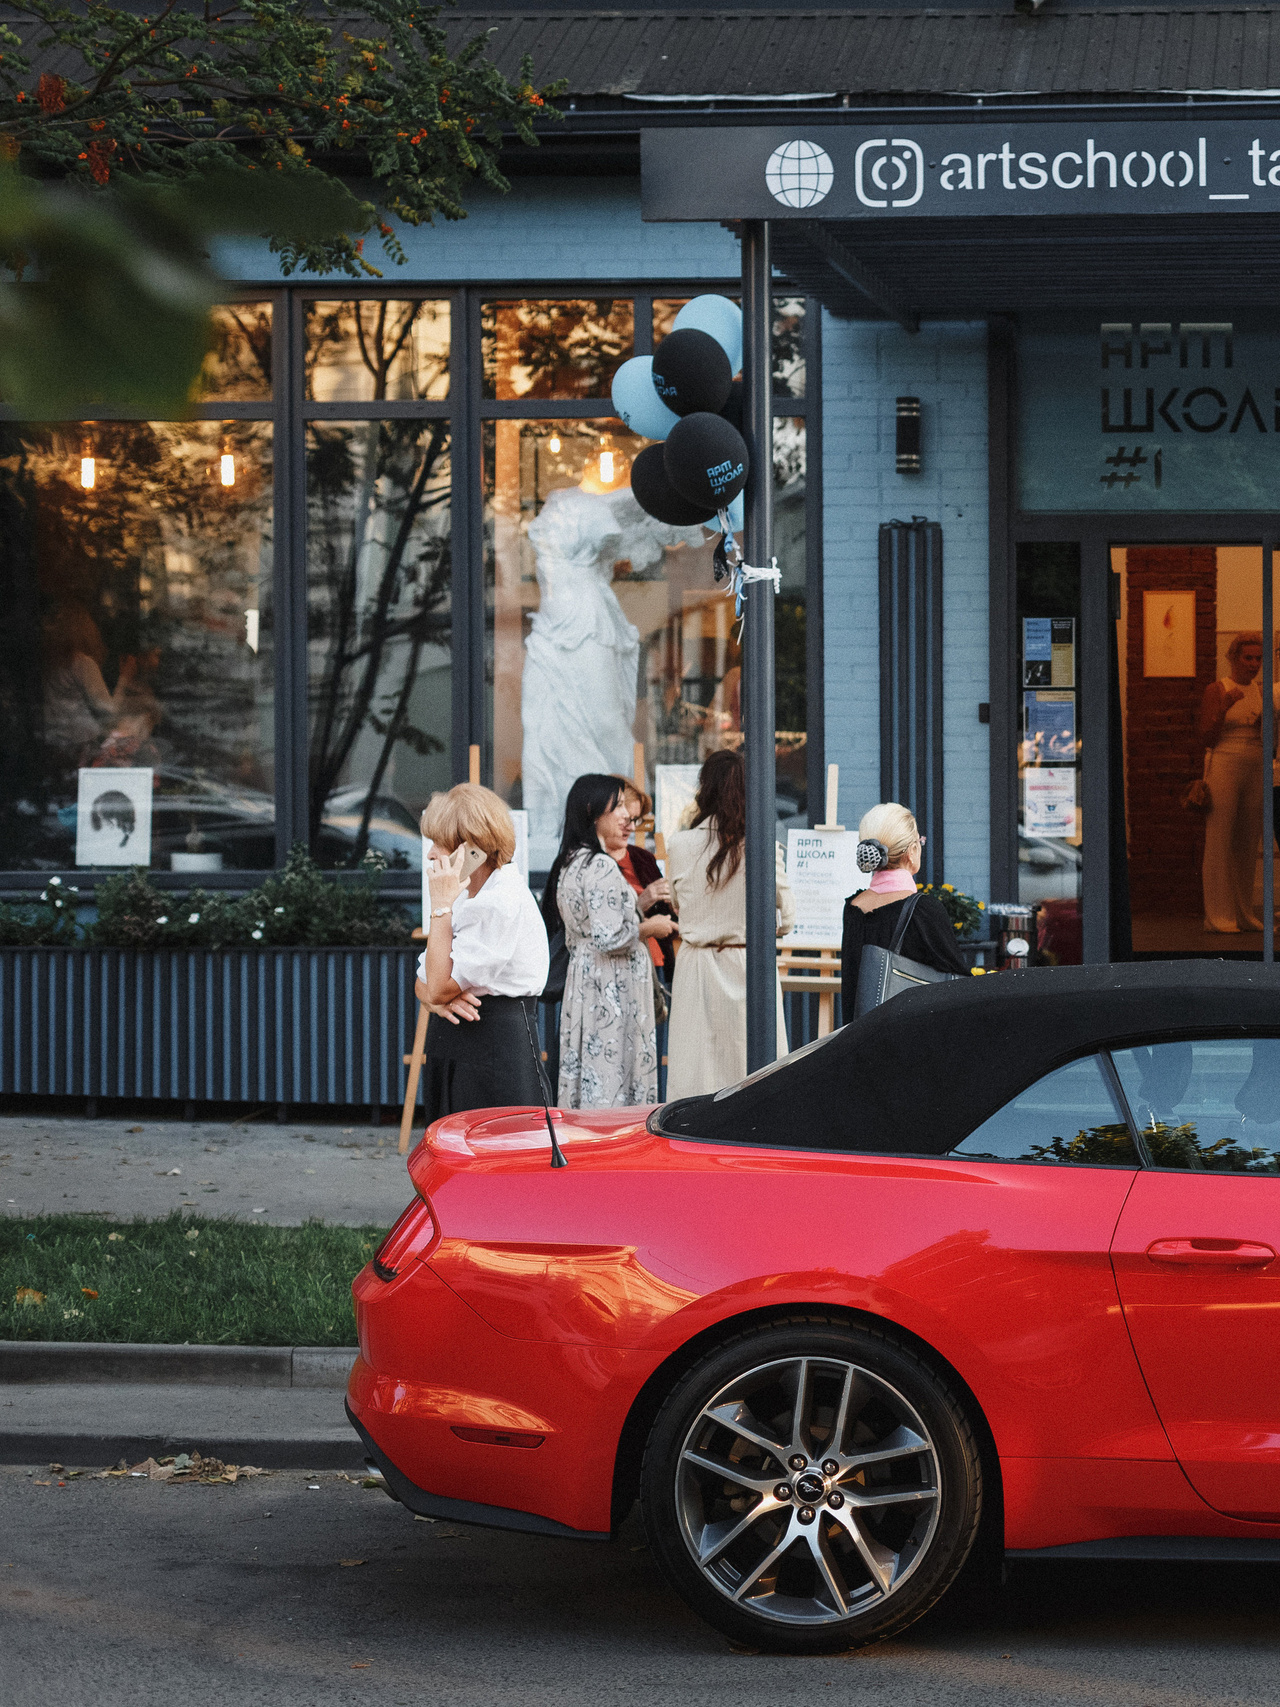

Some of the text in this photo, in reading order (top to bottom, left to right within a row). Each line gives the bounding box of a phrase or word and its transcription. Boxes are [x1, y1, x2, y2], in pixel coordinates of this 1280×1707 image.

[710, 463, 744, 487] ШКОЛА
[1100, 446, 1163, 490] #1
[796, 849, 835, 860] ШКОЛА
